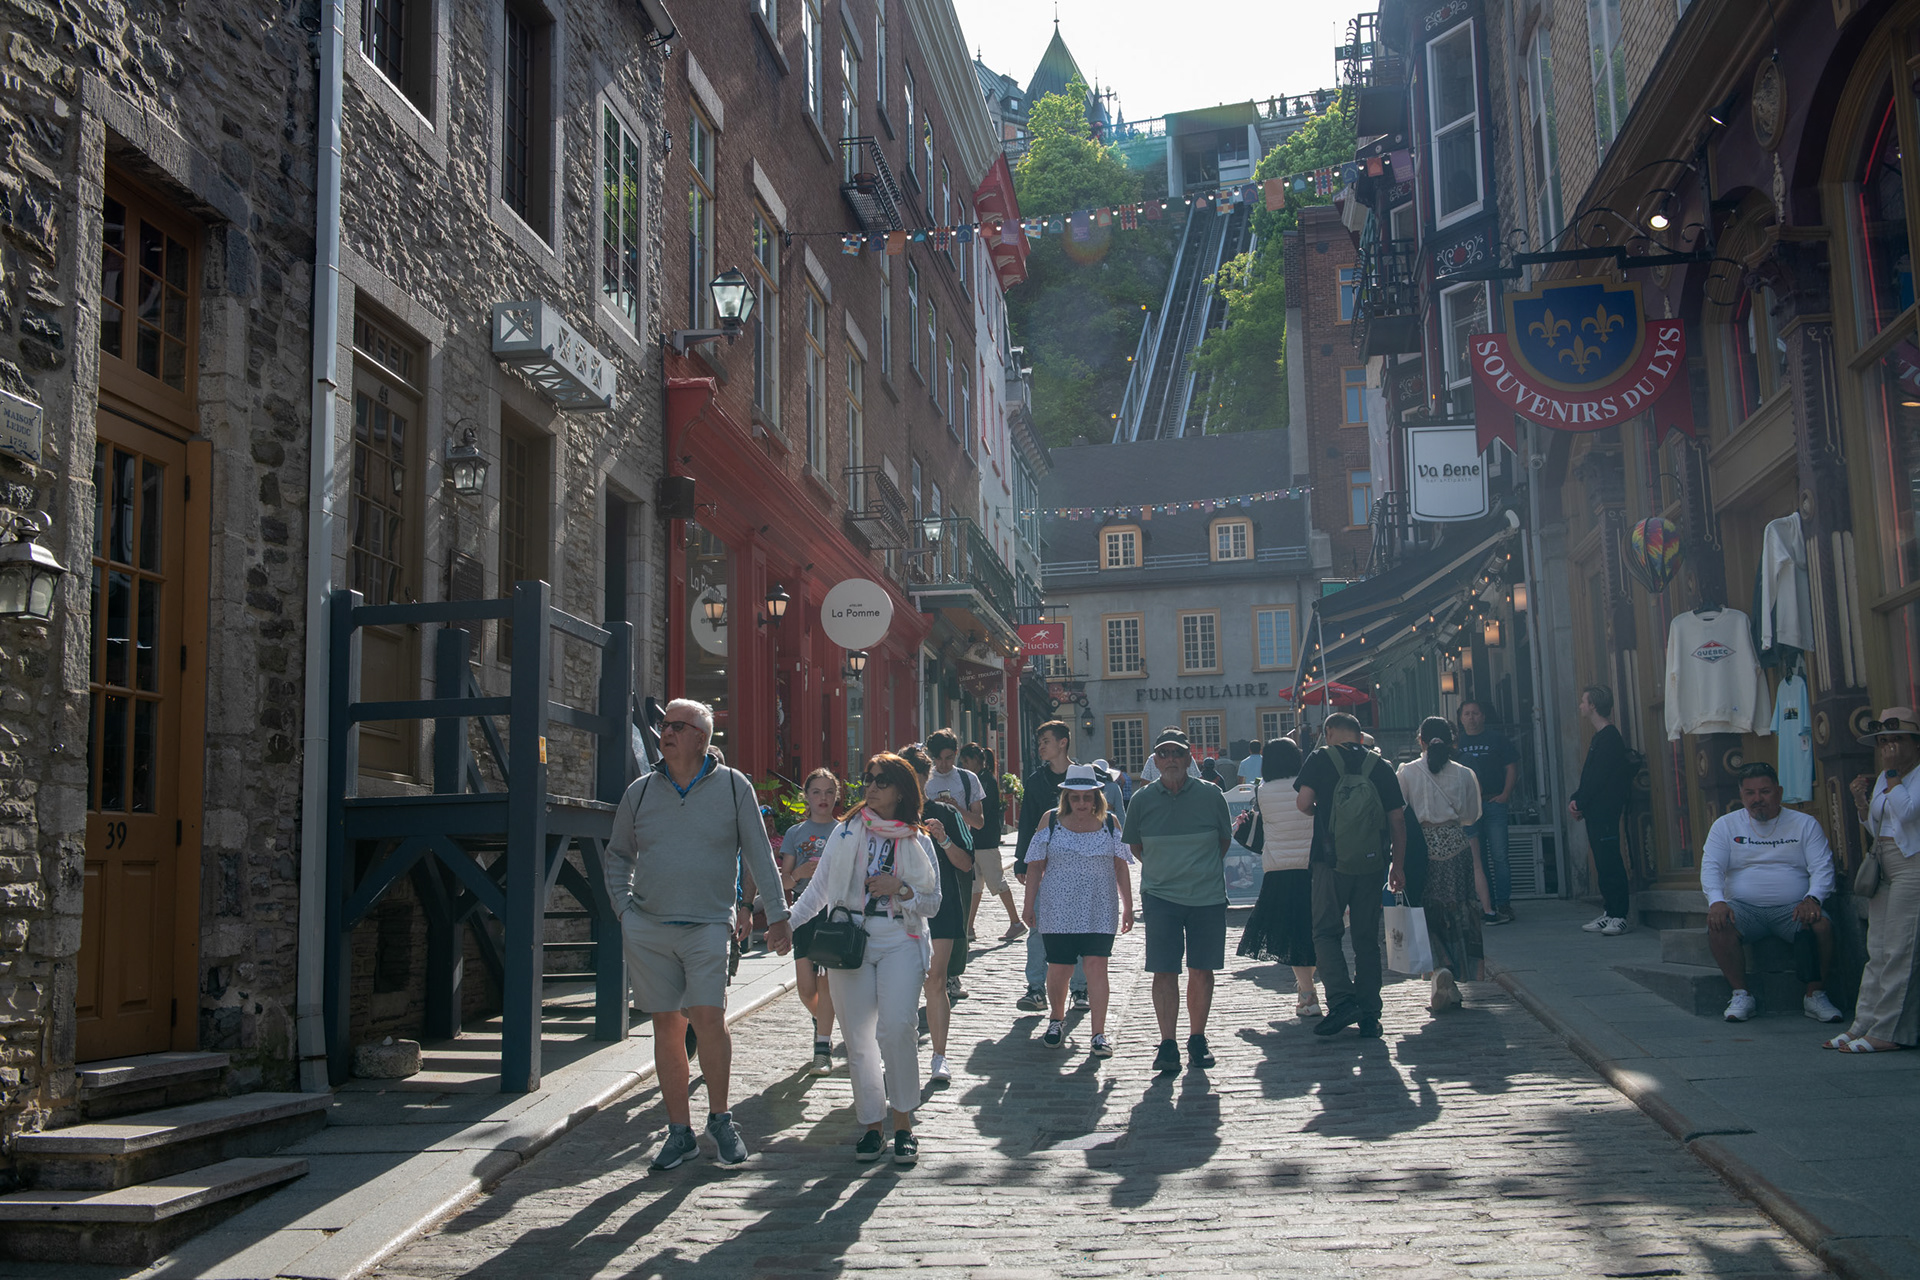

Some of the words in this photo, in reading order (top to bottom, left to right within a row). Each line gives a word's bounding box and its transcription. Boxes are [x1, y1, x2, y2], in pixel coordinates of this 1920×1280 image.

[1476, 340, 1619, 423] SOUVENIRS
[1620, 376, 1655, 409] DU
[1646, 327, 1681, 379] LYS
[378, 385, 389, 405] 41
[3, 407, 34, 427] MAISON
[6, 420, 32, 437] LEDUC
[9, 436, 28, 449] 1725
[1417, 464, 1438, 478] Va
[1443, 463, 1480, 477] Bene
[831, 609, 843, 618] La
[846, 608, 880, 617] Pomme
[1024, 642, 1059, 650] Fluchos
[1136, 682, 1269, 702] FUNICULAIRE
[105, 821, 128, 851] 39
[1733, 836, 1799, 848] Champion
